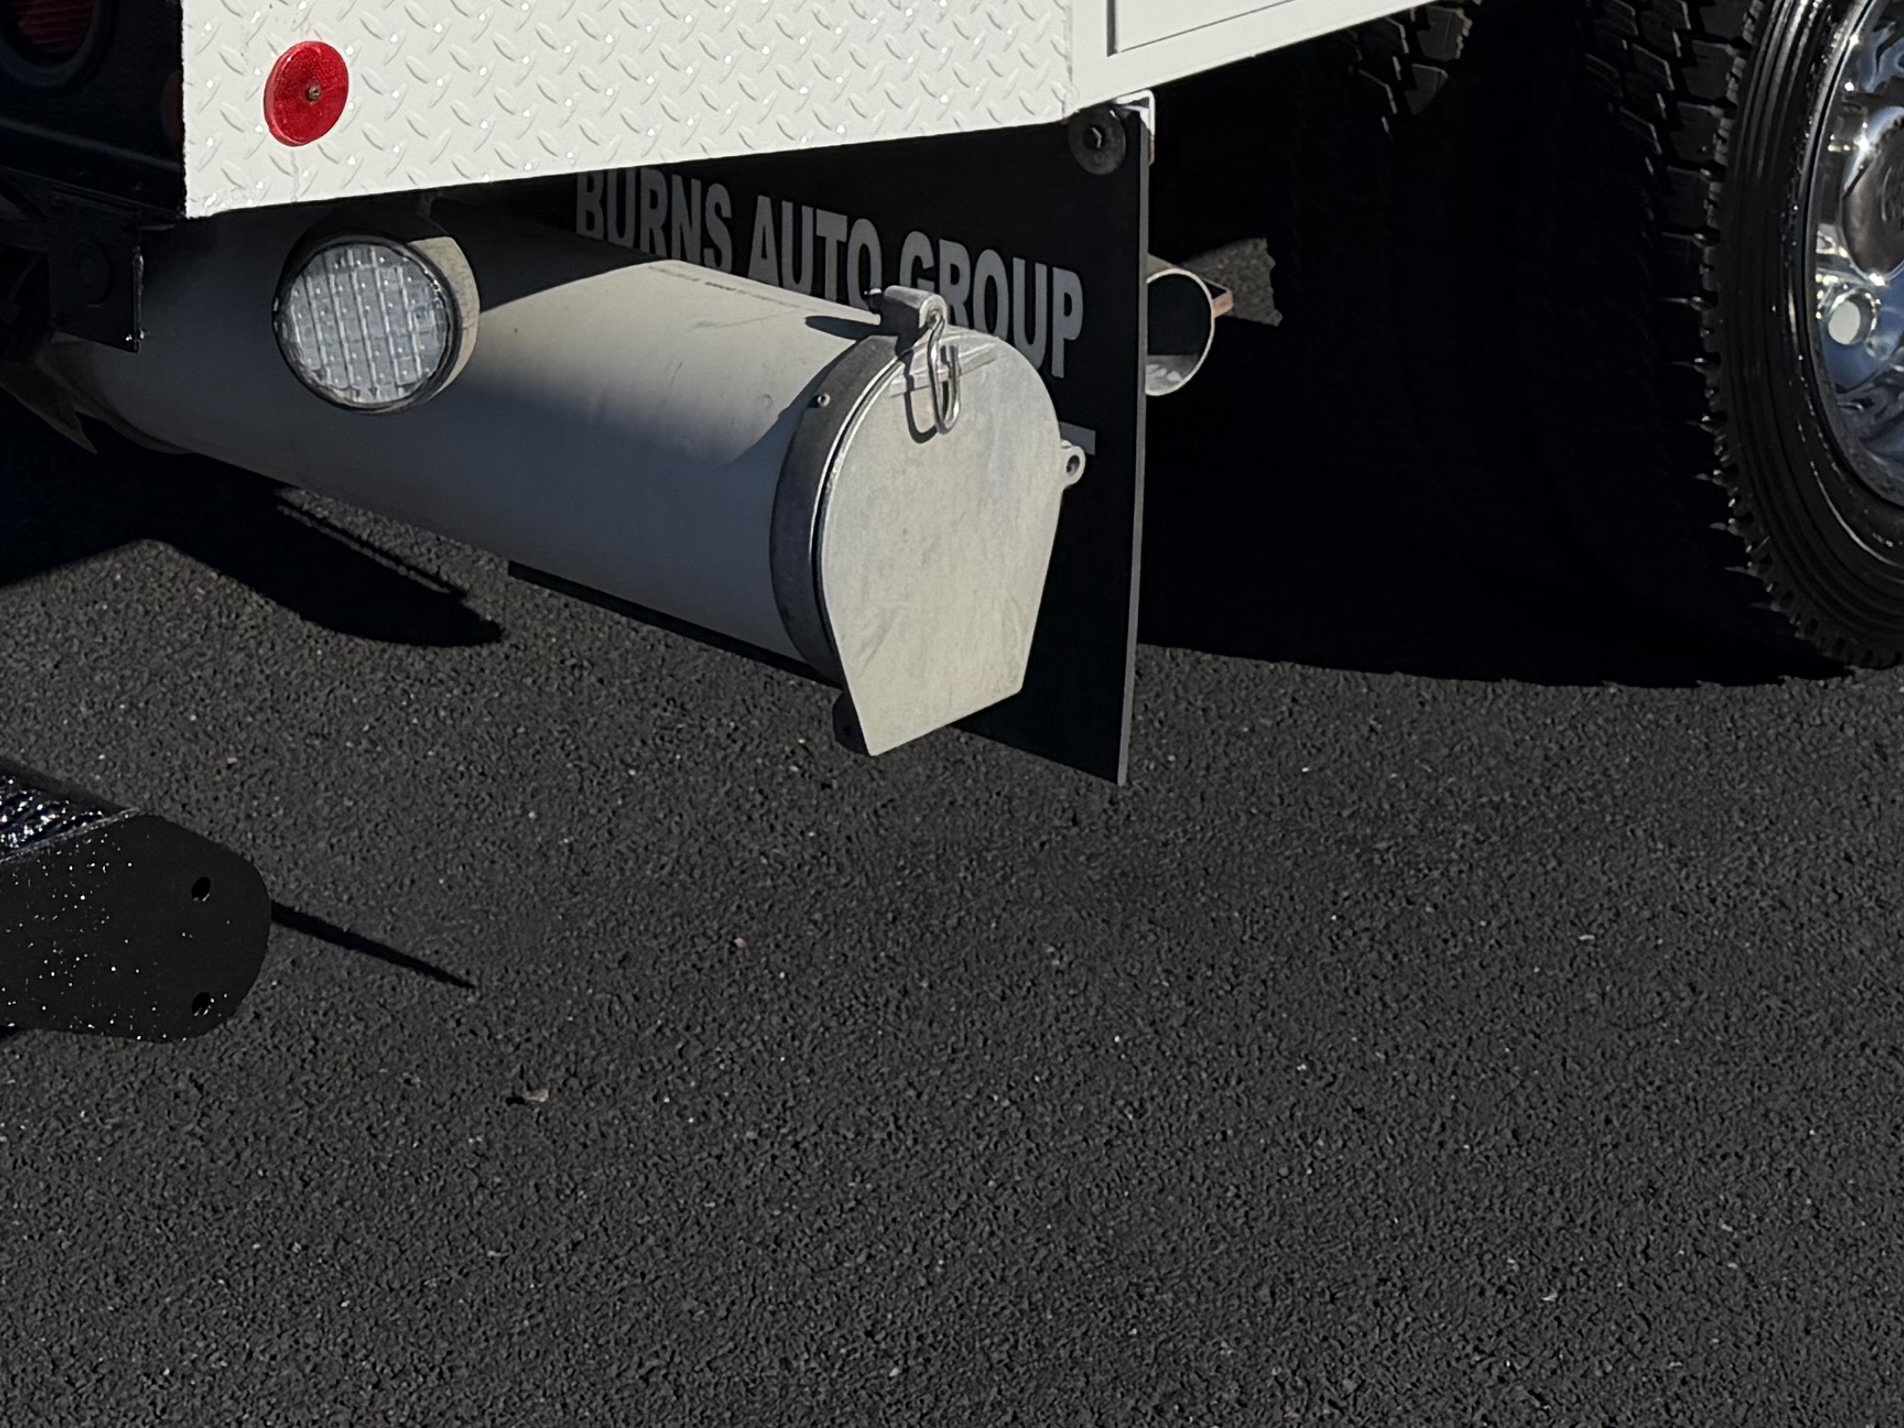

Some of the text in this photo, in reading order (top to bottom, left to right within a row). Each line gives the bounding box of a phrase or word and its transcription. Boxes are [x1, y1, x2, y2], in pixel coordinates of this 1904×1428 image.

[576, 170, 1085, 379] BURNS AUTO GROUP
